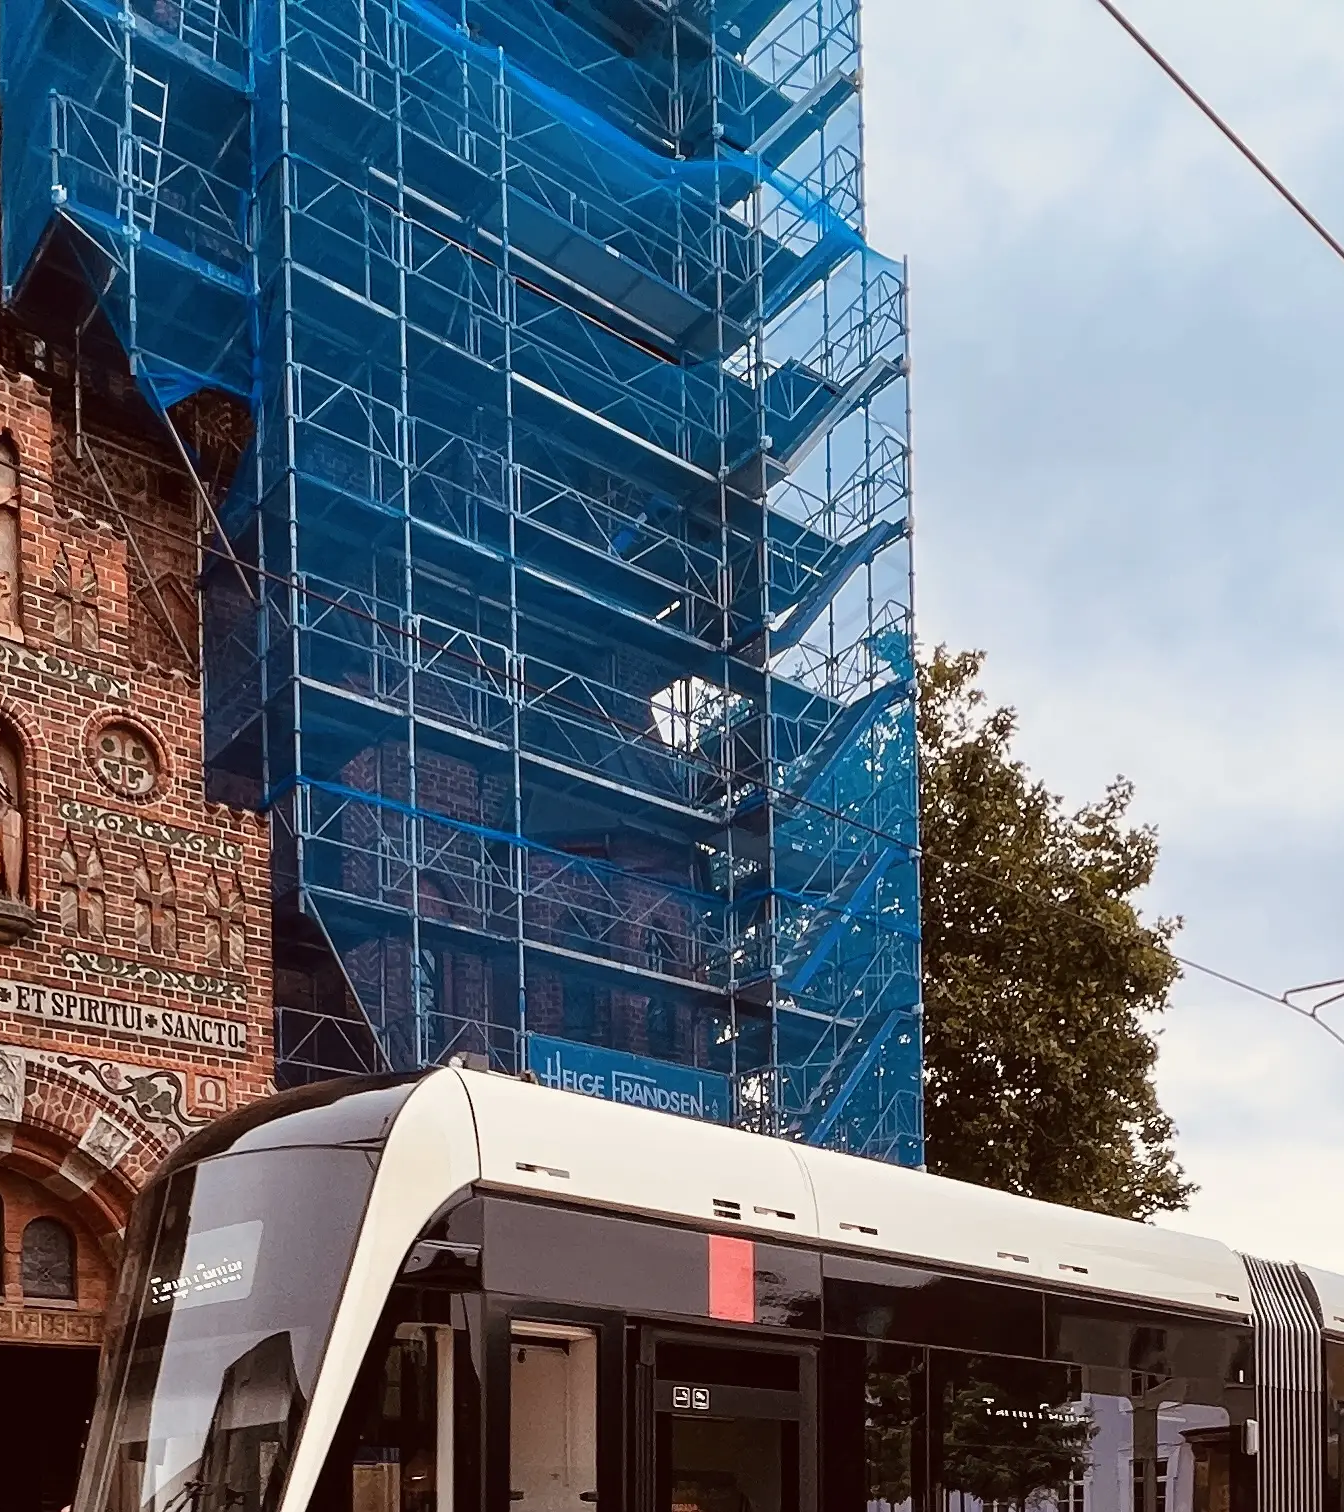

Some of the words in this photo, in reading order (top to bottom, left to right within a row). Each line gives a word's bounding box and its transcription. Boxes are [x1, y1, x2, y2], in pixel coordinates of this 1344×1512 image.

[14, 984, 47, 1014] ET
[51, 992, 143, 1031] SPIRITUI
[540, 1050, 605, 1099] HELGE
